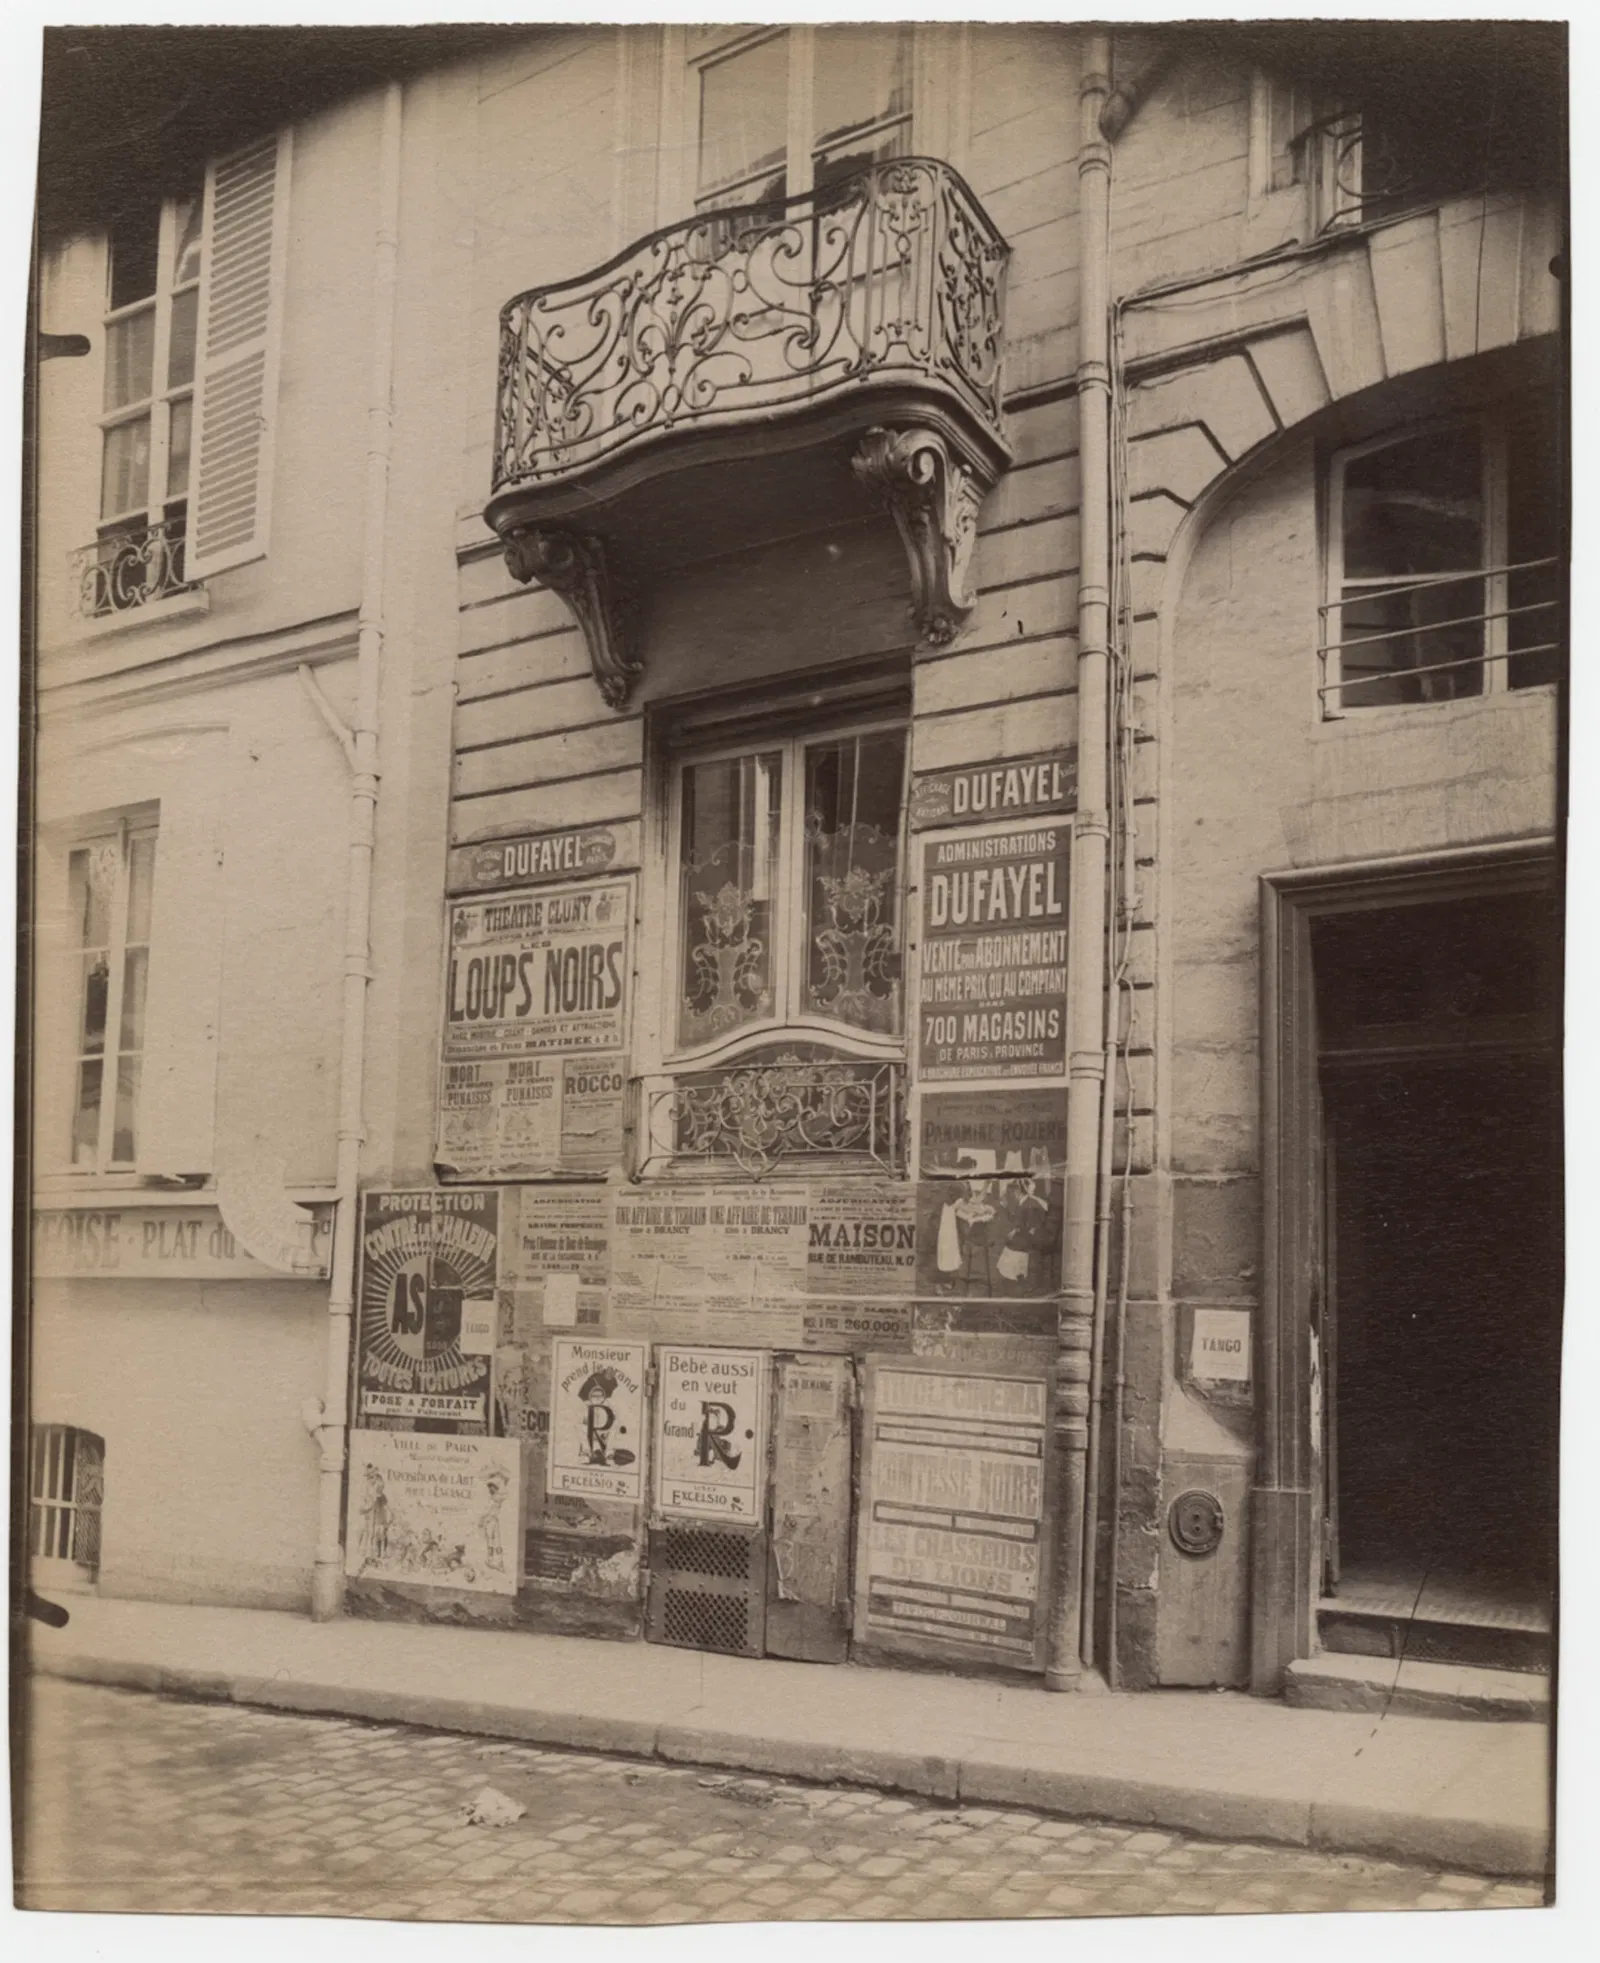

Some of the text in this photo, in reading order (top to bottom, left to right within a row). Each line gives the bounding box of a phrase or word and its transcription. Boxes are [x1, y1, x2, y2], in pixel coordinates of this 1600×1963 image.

[953, 762, 1063, 815] DUFAYEL
[504, 836, 583, 877] DUFAYEL
[937, 831, 1056, 863] ADMINISTRATIONS
[931, 862, 1061, 927] DUFAYEL
[548, 895, 592, 925] CLUNY
[521, 941, 552, 950] LES
[923, 940, 961, 973] VENTE
[976, 931, 1067, 969] ABONNEMENT
[450, 941, 622, 1022] LOUPS NOIRS
[965, 974, 988, 1000] PRIX
[989, 973, 1001, 998] OU
[1004, 971, 1017, 996] AU
[1018, 967, 1066, 996] COMPTANT
[925, 1009, 1059, 1046] 700 MAGASINS
[939, 1043, 1045, 1062] DE PARIS PROVINCE
[450, 1064, 481, 1083] MORT
[508, 1060, 540, 1078] MORT
[506, 1085, 553, 1102] PUNAISES
[565, 1074, 622, 1095] ROCCO
[448, 1090, 491, 1106] PUNAISES
[380, 1193, 486, 1212] PROTECTION
[142, 1220, 203, 1260] PLAT
[365, 1214, 417, 1261] CONTRE
[432, 1214, 497, 1263] CHALEUR
[653, 1226, 690, 1235] DRANCY
[750, 1226, 790, 1235] DRANCY
[808, 1222, 916, 1248] MAISON
[808, 1253, 825, 1264] RUE
[827, 1253, 837, 1264] DE
[844, 1319, 900, 1333] 260.000
[572, 1345, 632, 1361] Monsieur
[1201, 1337, 1241, 1354] TANGO
[363, 1351, 414, 1392] TOUTES
[418, 1356, 487, 1393] TOITURES
[561, 1363, 589, 1392] prend
[711, 1362, 754, 1377] aussi
[682, 1380, 738, 1396] en veut
[371, 1394, 402, 1406] POSE
[420, 1397, 478, 1410] FORFAIT
[670, 1398, 687, 1411] du
[664, 1420, 695, 1440] Grand
[392, 1438, 421, 1451] VILLE
[445, 1440, 479, 1453] PARIS
[387, 1468, 438, 1483] EXPOSITION
[980, 1460, 1040, 1518] NOIRE
[913, 1531, 1036, 1574] CHASSEURS
[934, 1564, 1013, 1595] LIONS
